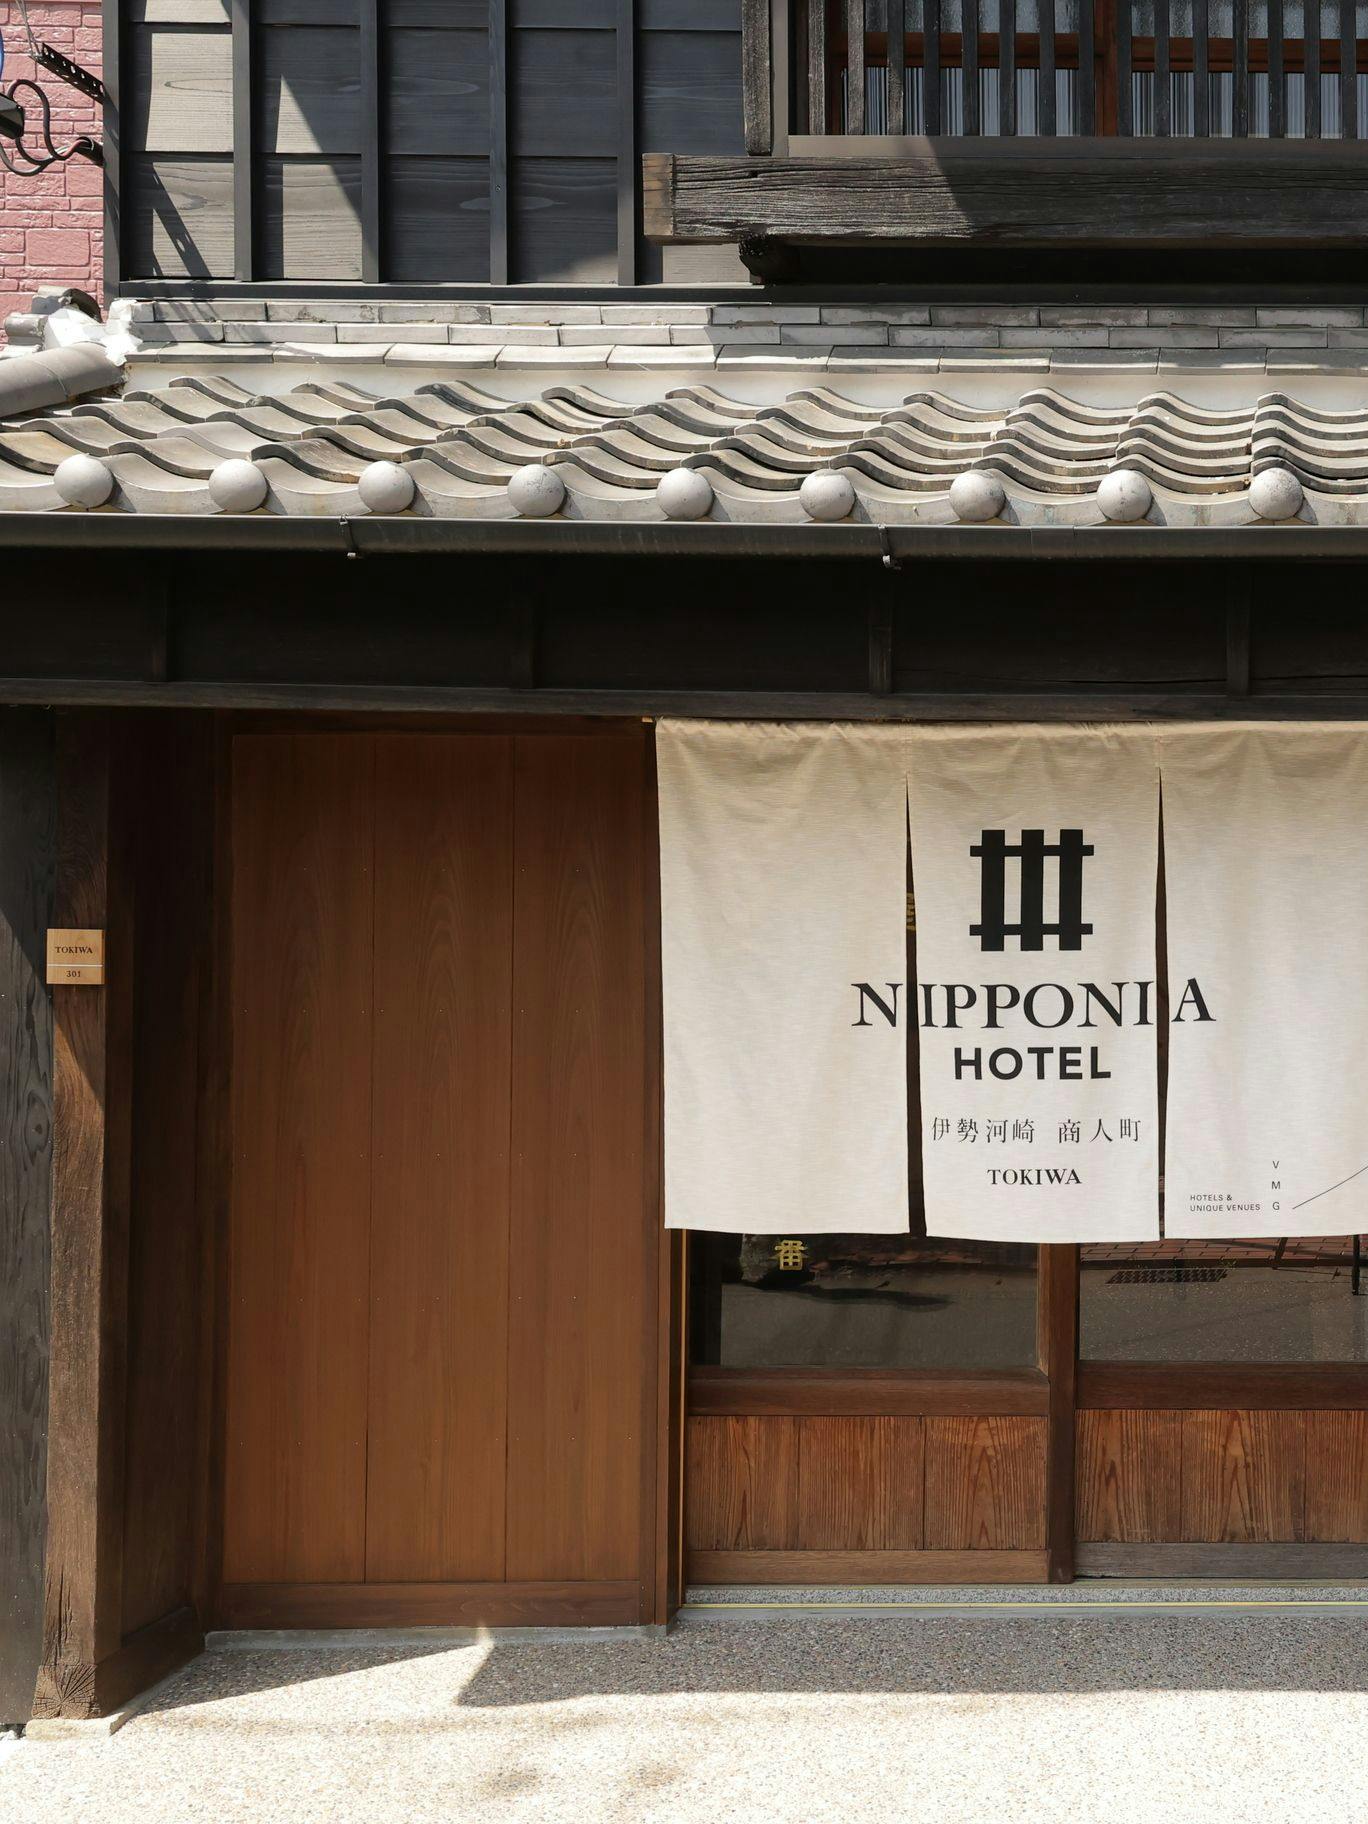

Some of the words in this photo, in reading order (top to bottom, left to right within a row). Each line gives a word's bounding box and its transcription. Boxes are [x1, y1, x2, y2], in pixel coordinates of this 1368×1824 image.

[55, 946, 93, 954] TOKIWA
[851, 978, 1216, 1028] NIPPONIA
[954, 1046, 1111, 1080] HOTEL
[931, 1116, 1035, 1144] 伊勢河崎
[1057, 1117, 1142, 1144] 商人町
[987, 1168, 1083, 1185] TOKIWA
[1190, 1194, 1224, 1202] HOTELS
[1226, 1203, 1261, 1211] VENUES
